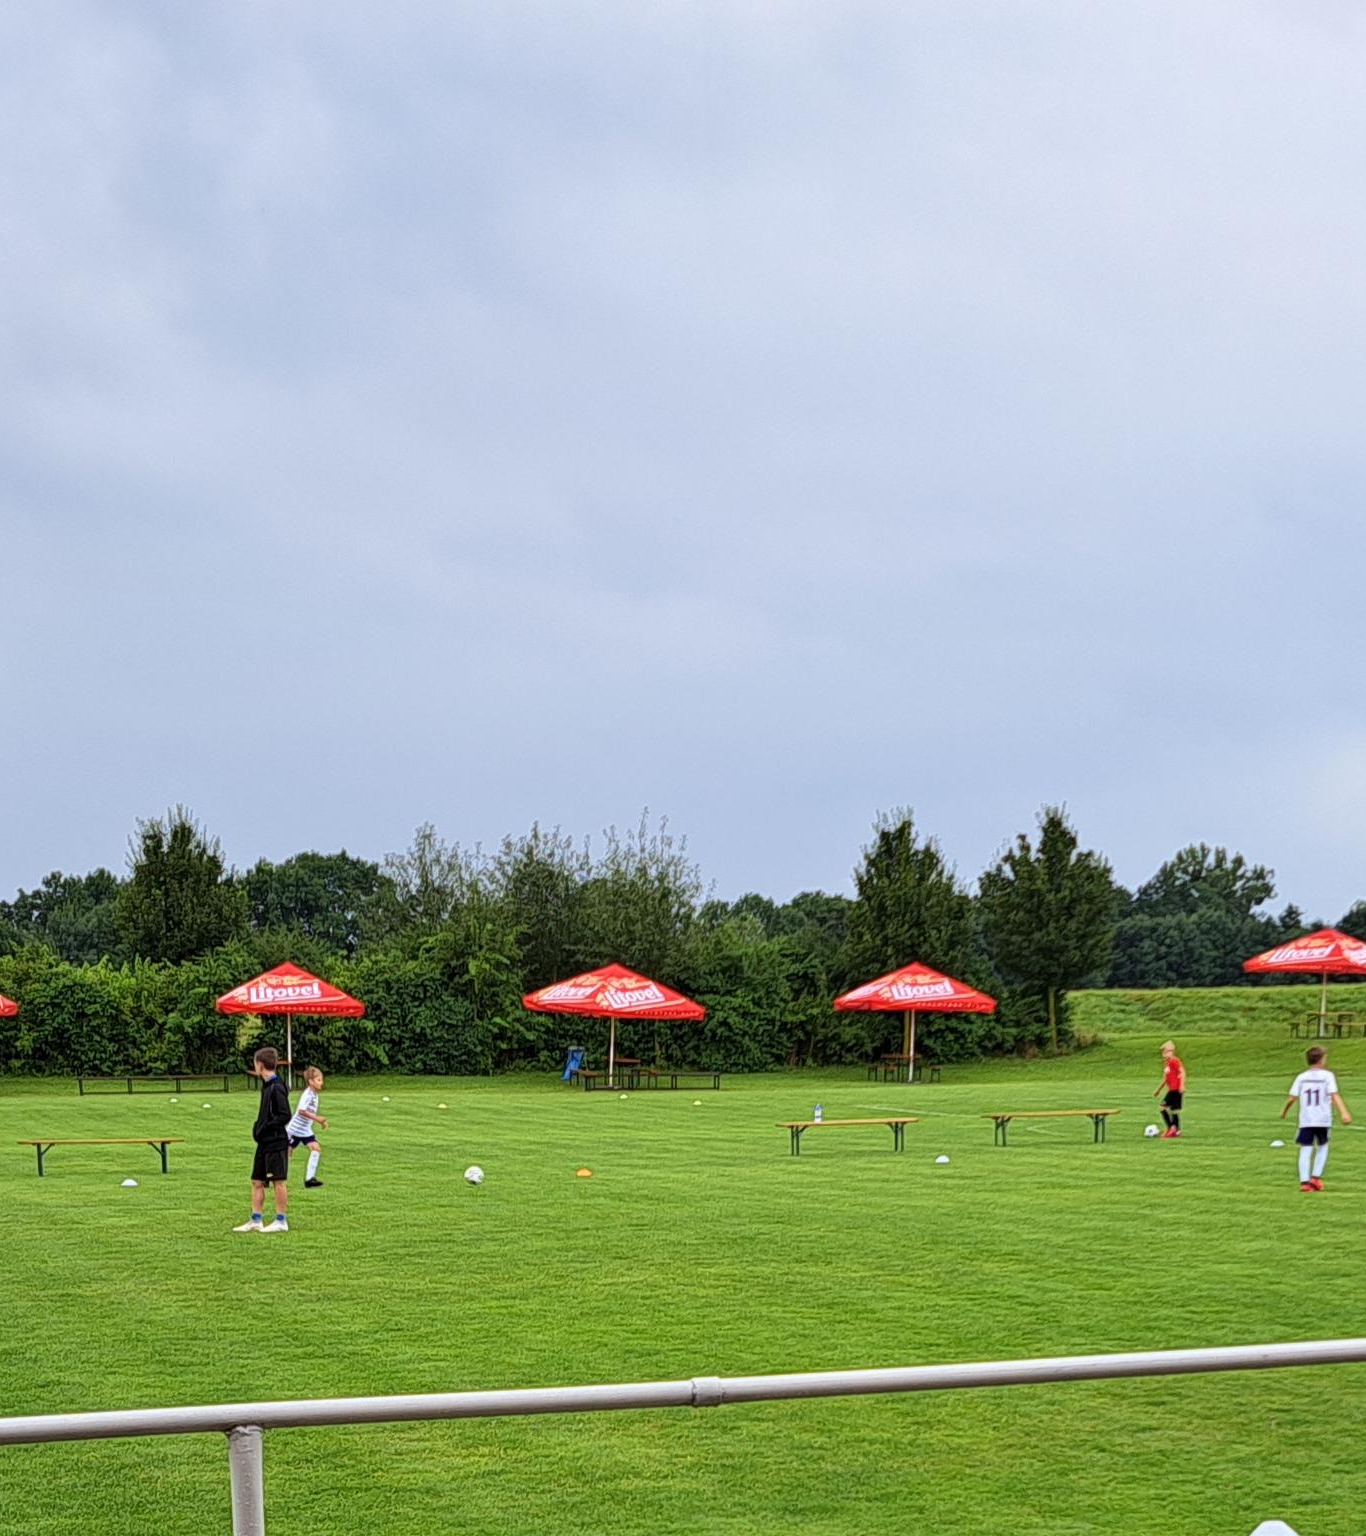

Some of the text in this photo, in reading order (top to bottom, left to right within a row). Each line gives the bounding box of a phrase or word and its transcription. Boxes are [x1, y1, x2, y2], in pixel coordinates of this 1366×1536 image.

[250, 982, 321, 1003] Litovel
[606, 982, 665, 1009] Litovel
[1304, 1088, 1320, 1106] 11
